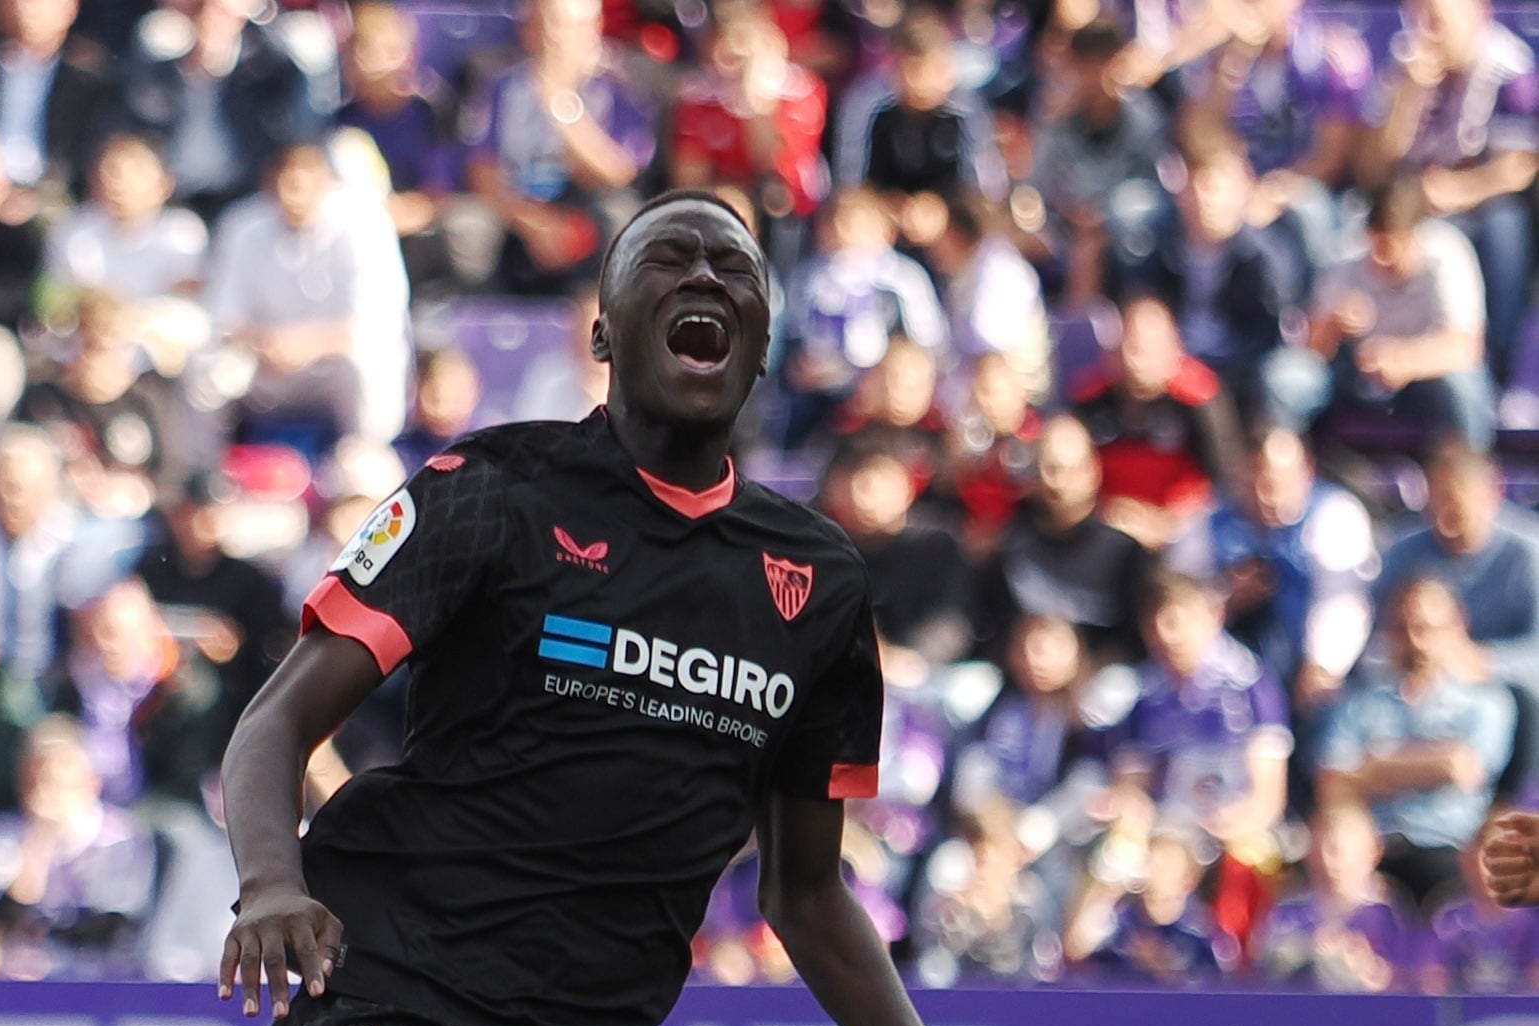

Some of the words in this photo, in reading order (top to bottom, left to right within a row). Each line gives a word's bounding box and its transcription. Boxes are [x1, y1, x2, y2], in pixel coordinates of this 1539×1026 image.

[544, 675, 636, 710] EUROPE'S
[639, 695, 714, 729] LEADING
[613, 628, 795, 719] DEGIRO
